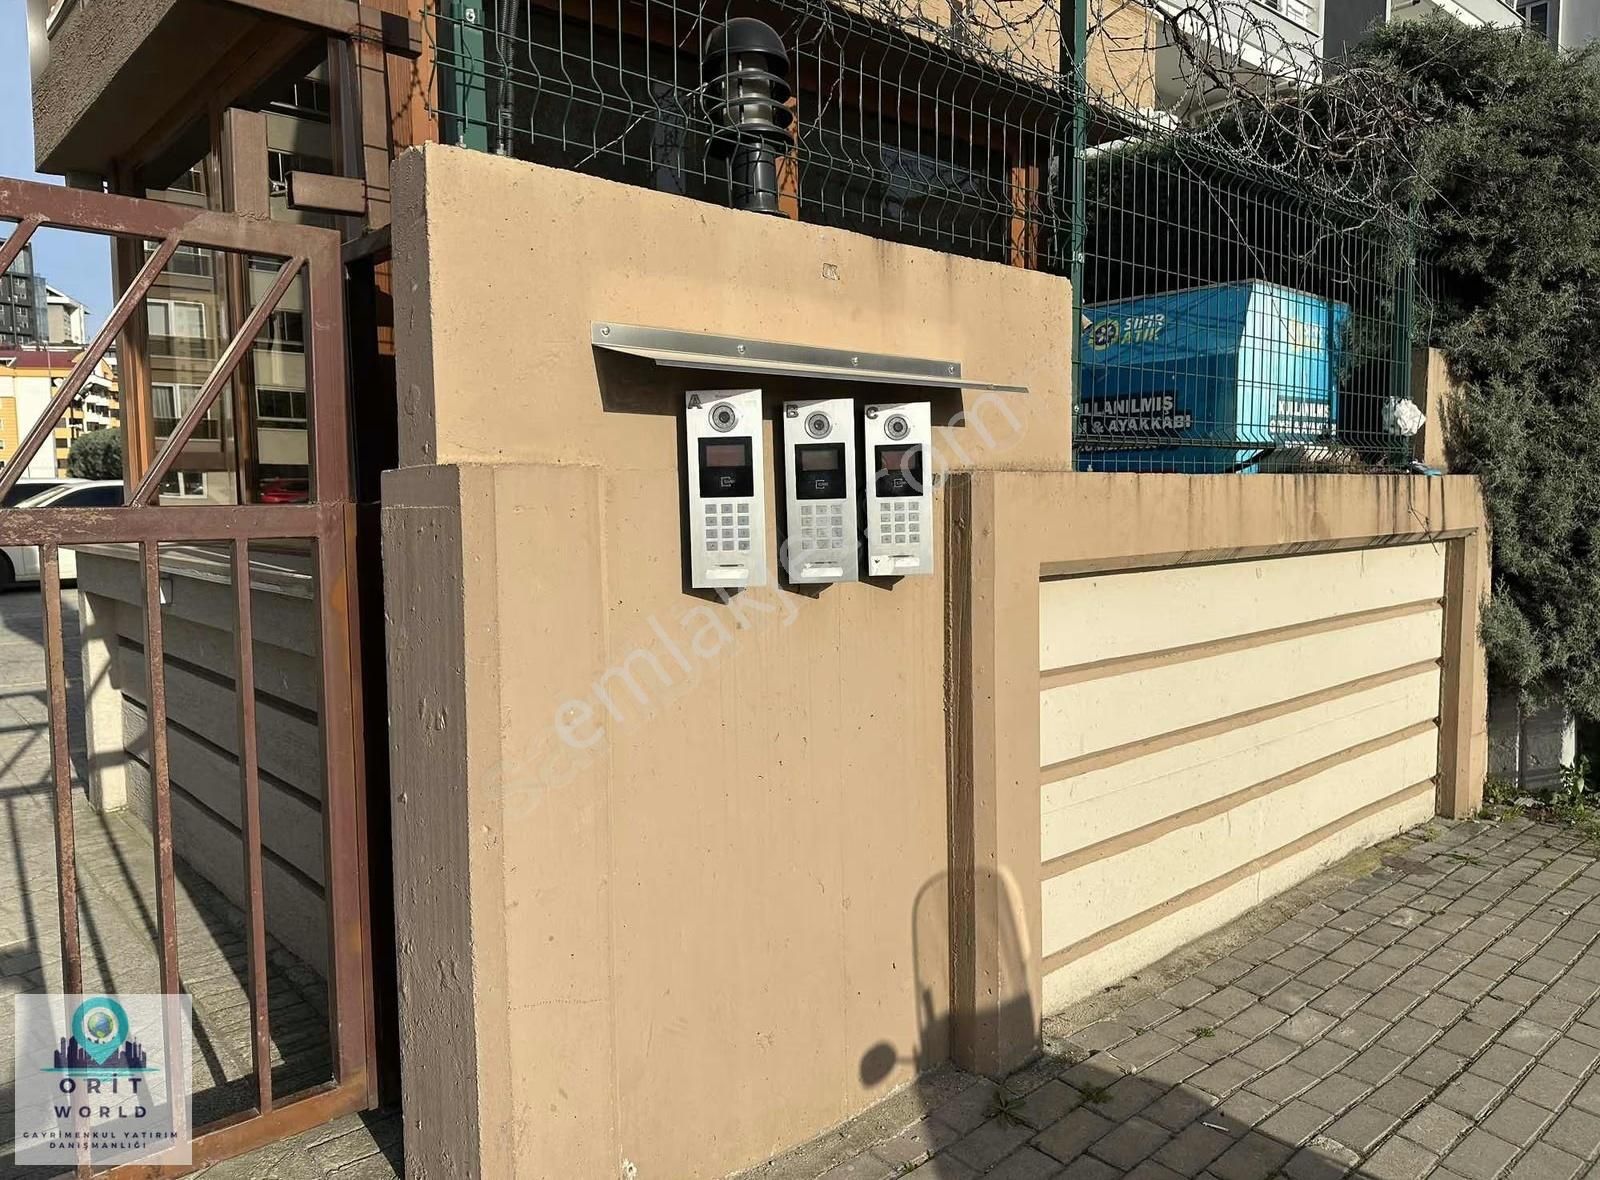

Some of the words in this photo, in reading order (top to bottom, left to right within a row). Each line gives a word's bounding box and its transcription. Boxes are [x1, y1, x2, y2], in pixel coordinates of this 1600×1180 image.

[688, 393, 703, 409] A
[786, 404, 799, 418] B
[865, 406, 879, 420] C
[1108, 415, 1191, 432] AYAKKABI
